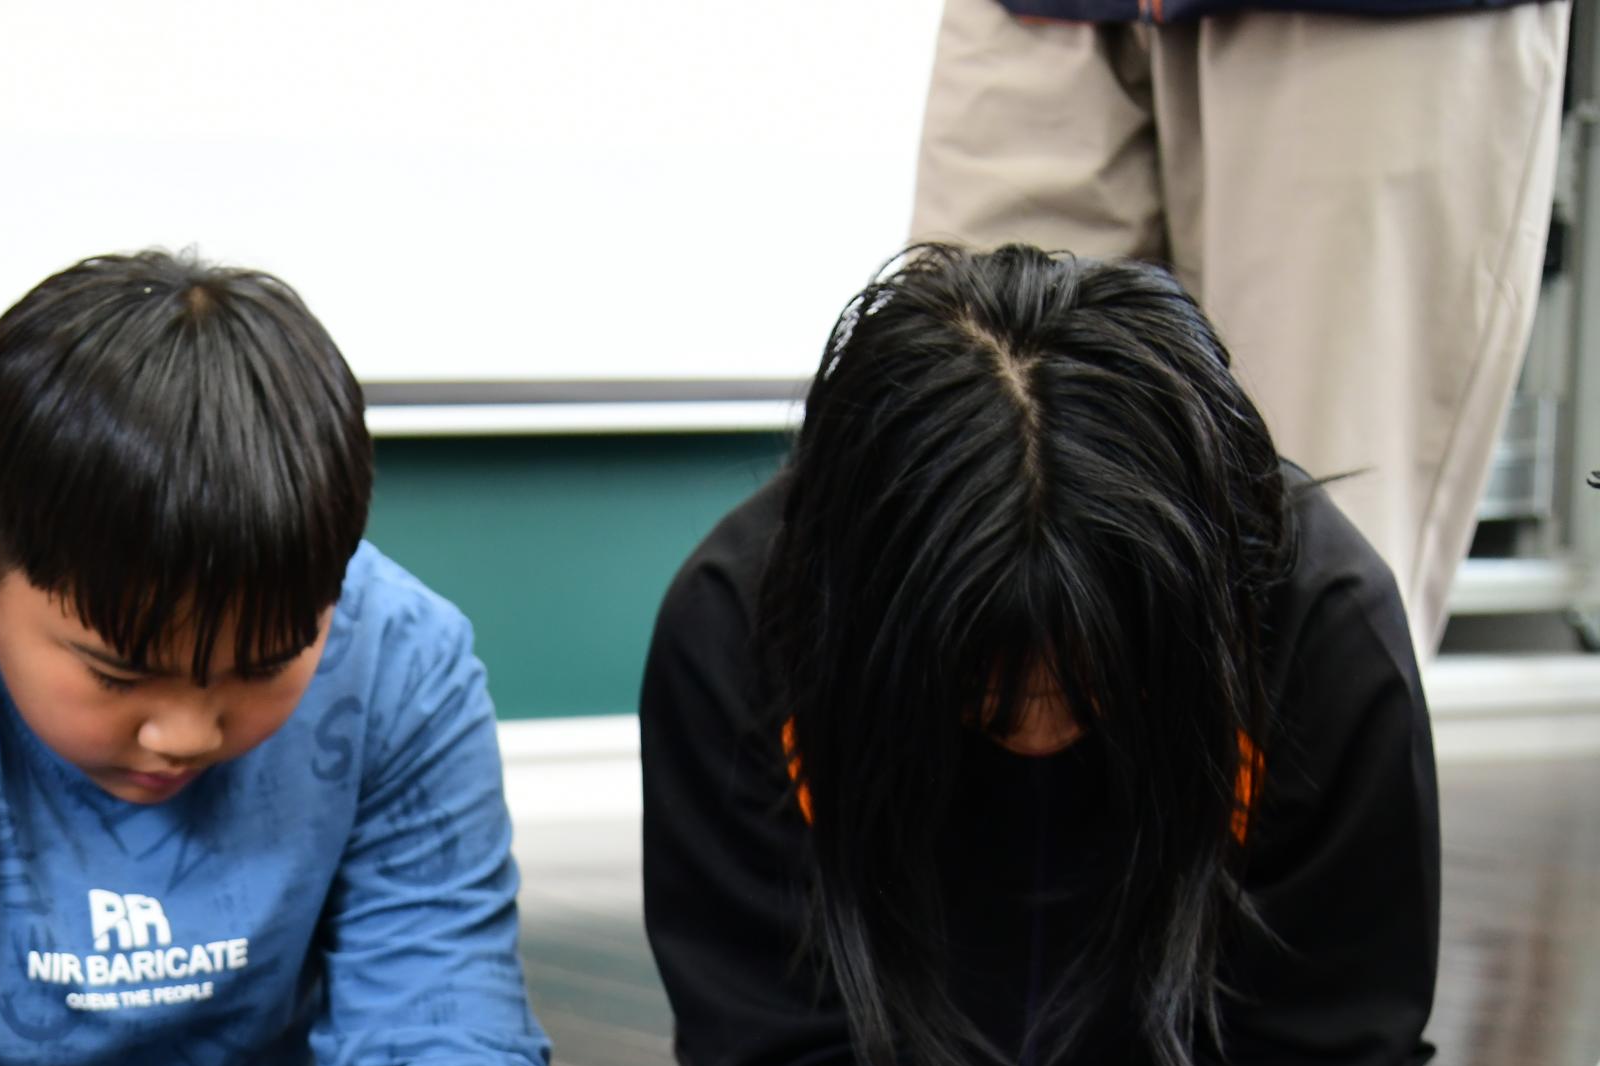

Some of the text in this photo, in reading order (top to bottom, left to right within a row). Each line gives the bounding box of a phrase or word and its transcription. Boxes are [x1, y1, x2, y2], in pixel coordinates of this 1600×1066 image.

[27, 938, 249, 986] NIR BARICATE
[120, 989, 152, 1008] THE
[153, 981, 214, 1005] PEOPLE
